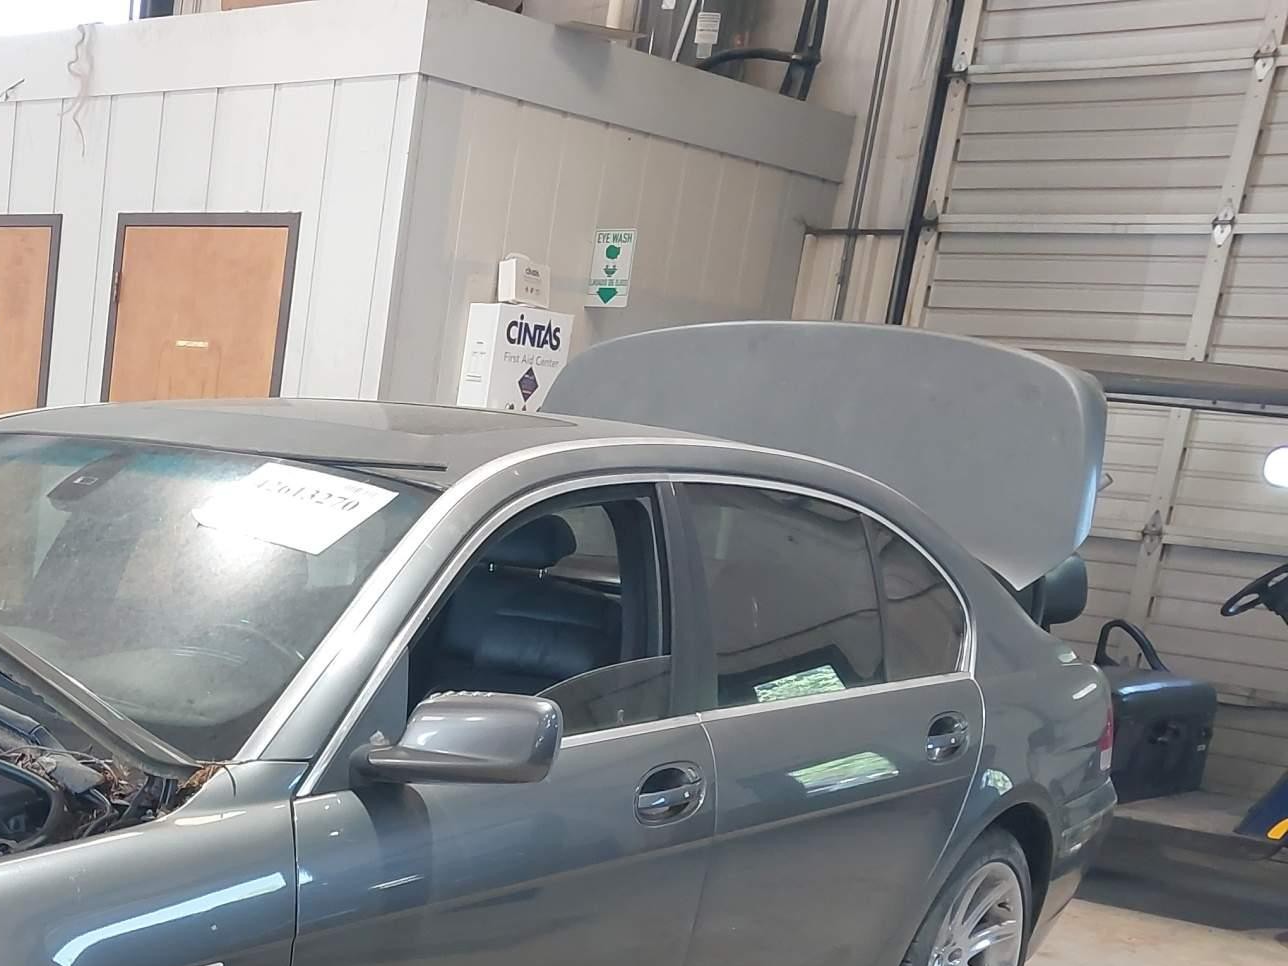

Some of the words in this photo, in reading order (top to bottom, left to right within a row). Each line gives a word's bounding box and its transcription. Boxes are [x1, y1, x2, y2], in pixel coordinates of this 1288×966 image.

[597, 232, 610, 244] EYE
[612, 232, 633, 244] WASH
[503, 351, 521, 365] First
[522, 353, 534, 365] Aid
[535, 355, 560, 368] Center
